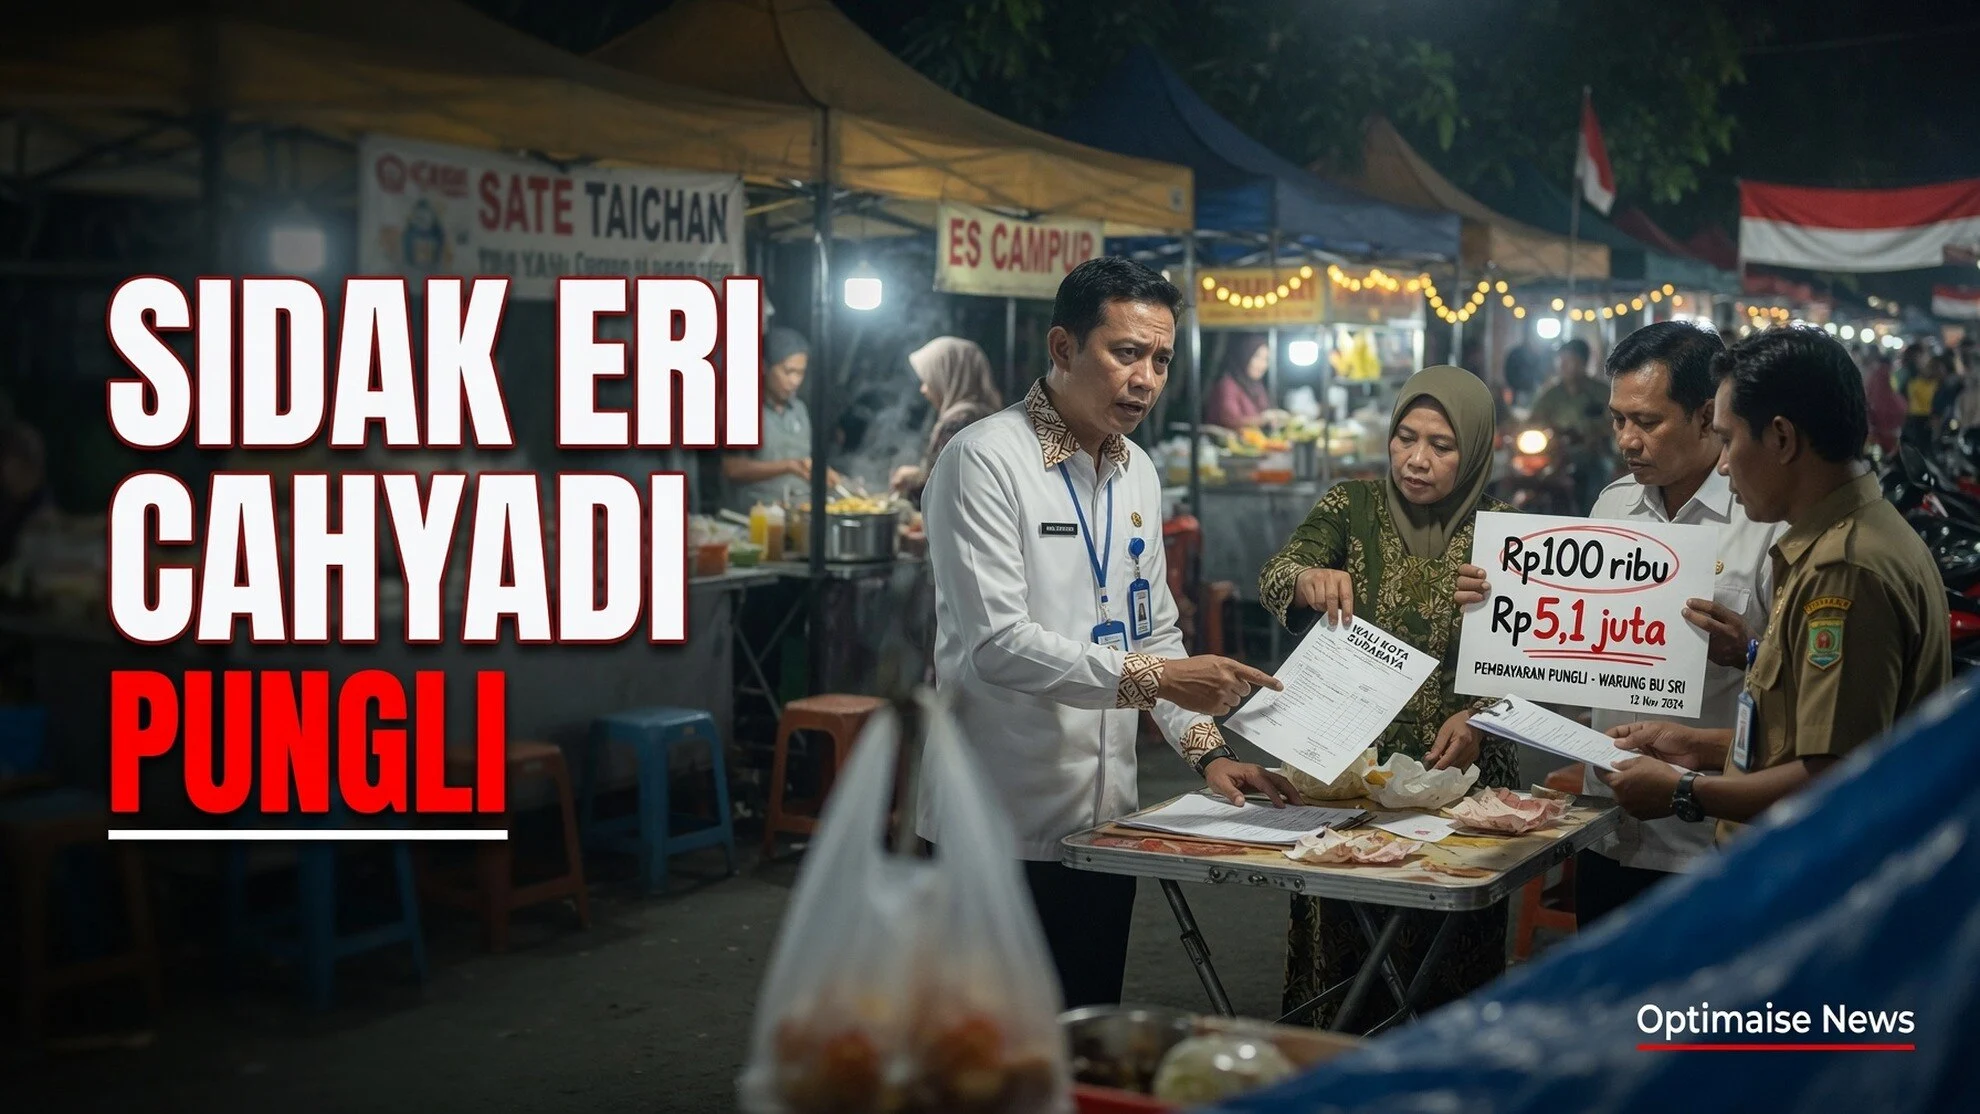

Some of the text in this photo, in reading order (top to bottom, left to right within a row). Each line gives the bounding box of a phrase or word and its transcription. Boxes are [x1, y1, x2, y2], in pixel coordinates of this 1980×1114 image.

[478, 171, 574, 236] SATE
[584, 181, 729, 244] TAICHAN
[948, 217, 1094, 275] ES CAMPUR
[1502, 536, 1669, 585] Rp100 ribu
[1491, 595, 1667, 653] Rp5,1 juta
[1474, 661, 1545, 681] PEMBAYARAN
[1548, 668, 1588, 685] PUNGLI
[1598, 673, 1646, 691] WARUNG
[1649, 678, 1665, 692] BU
[1667, 680, 1686, 694] SRI
